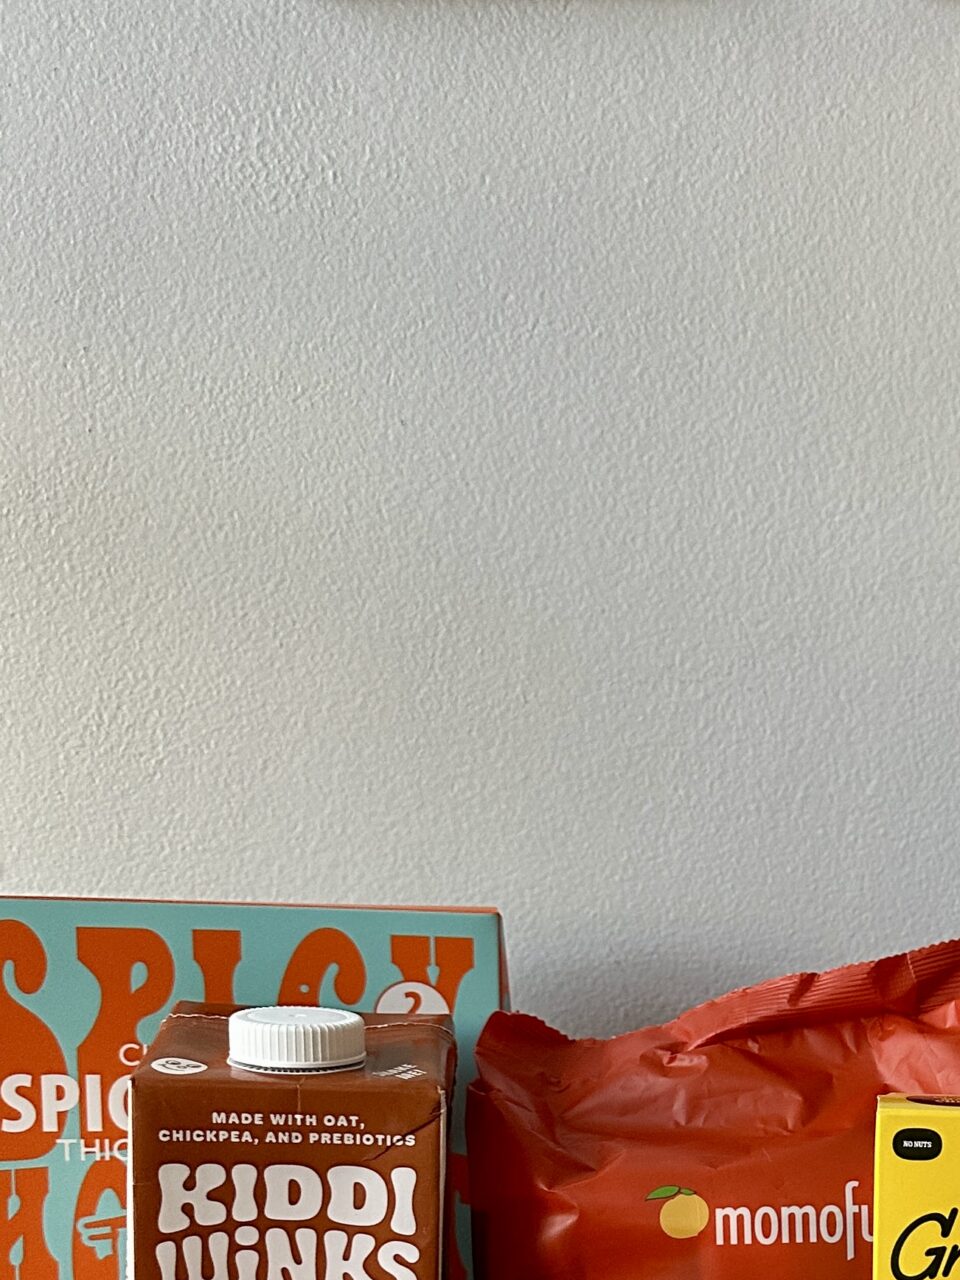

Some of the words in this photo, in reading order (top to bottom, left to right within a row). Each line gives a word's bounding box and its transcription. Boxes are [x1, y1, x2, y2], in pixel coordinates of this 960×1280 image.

[212, 1112, 264, 1125] MADE
[269, 1113, 317, 1127] WITH
[323, 1115, 365, 1130] OAT,
[158, 1129, 259, 1145] CHICKPEA,
[265, 1131, 302, 1144] AND
[308, 1132, 416, 1147] PREBIOTICS
[903, 1140, 913, 1148] NO
[914, 1140, 932, 1148] NUTS
[158, 1163, 417, 1236] KIDDI
